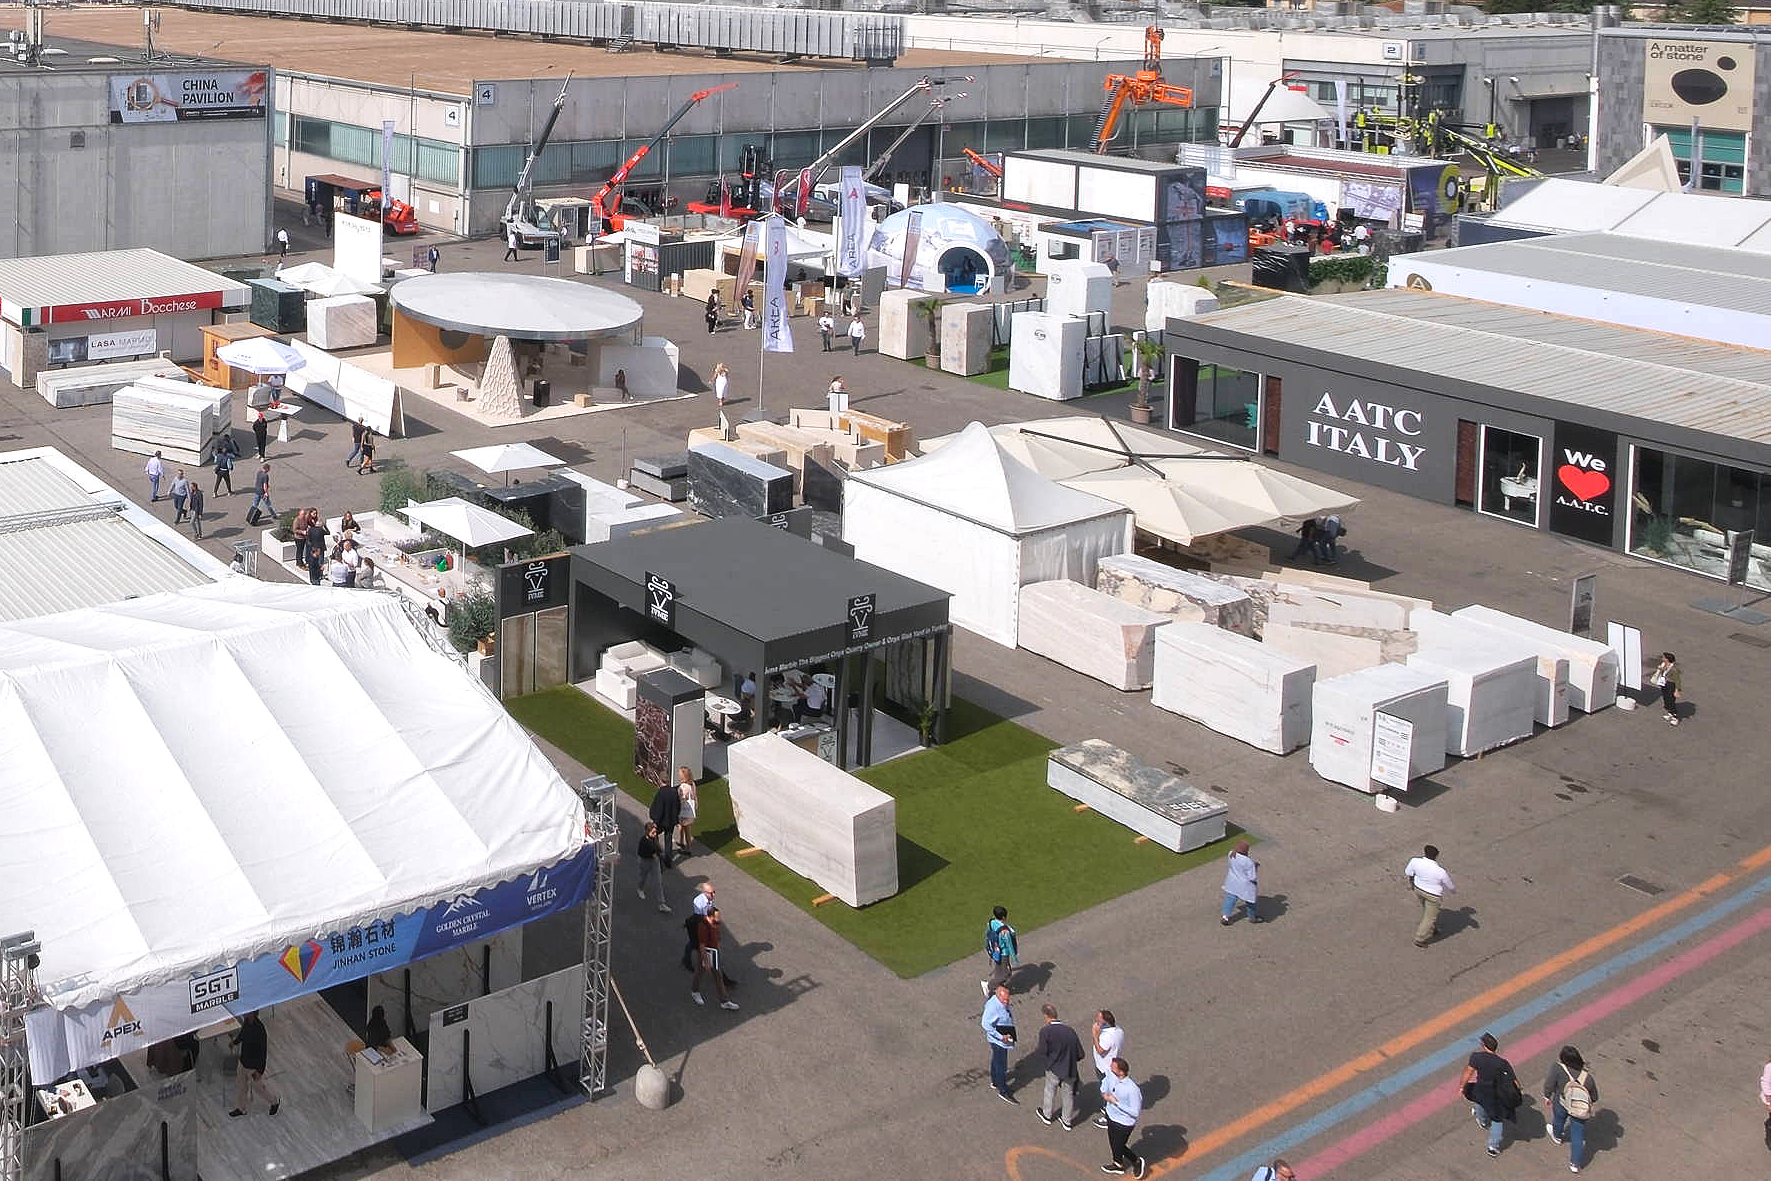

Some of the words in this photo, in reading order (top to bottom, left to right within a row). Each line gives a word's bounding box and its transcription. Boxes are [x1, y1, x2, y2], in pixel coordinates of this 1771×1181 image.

[1387, 46, 1396, 54] 2
[1651, 50, 1663, 59] of
[1667, 52, 1703, 60] stone
[1665, 44, 1708, 53] matter
[182, 79, 218, 91] CHINA
[182, 92, 234, 105] PAVILION
[482, 90, 491, 100] 4
[448, 111, 456, 120] 4
[92, 339, 116, 348] LASA
[1313, 392, 1421, 436] AATC
[1307, 421, 1426, 471] ITALY
[1564, 448, 1606, 471] We
[1556, 496, 1609, 516] A.A.T.C.
[526, 888, 557, 906] VERTEX
[436, 917, 462, 934] GOLDEN
[462, 909, 490, 925] CRYSTAL
[452, 922, 478, 937] MARBLE
[330, 919, 396, 954] 锦瀚石材
[332, 953, 366, 970] JINHAN
[367, 942, 396, 960] STONE
[194, 973, 234, 999] SGT
[195, 993, 234, 1012] MARBLE
[102, 1020, 142, 1041] APEX
